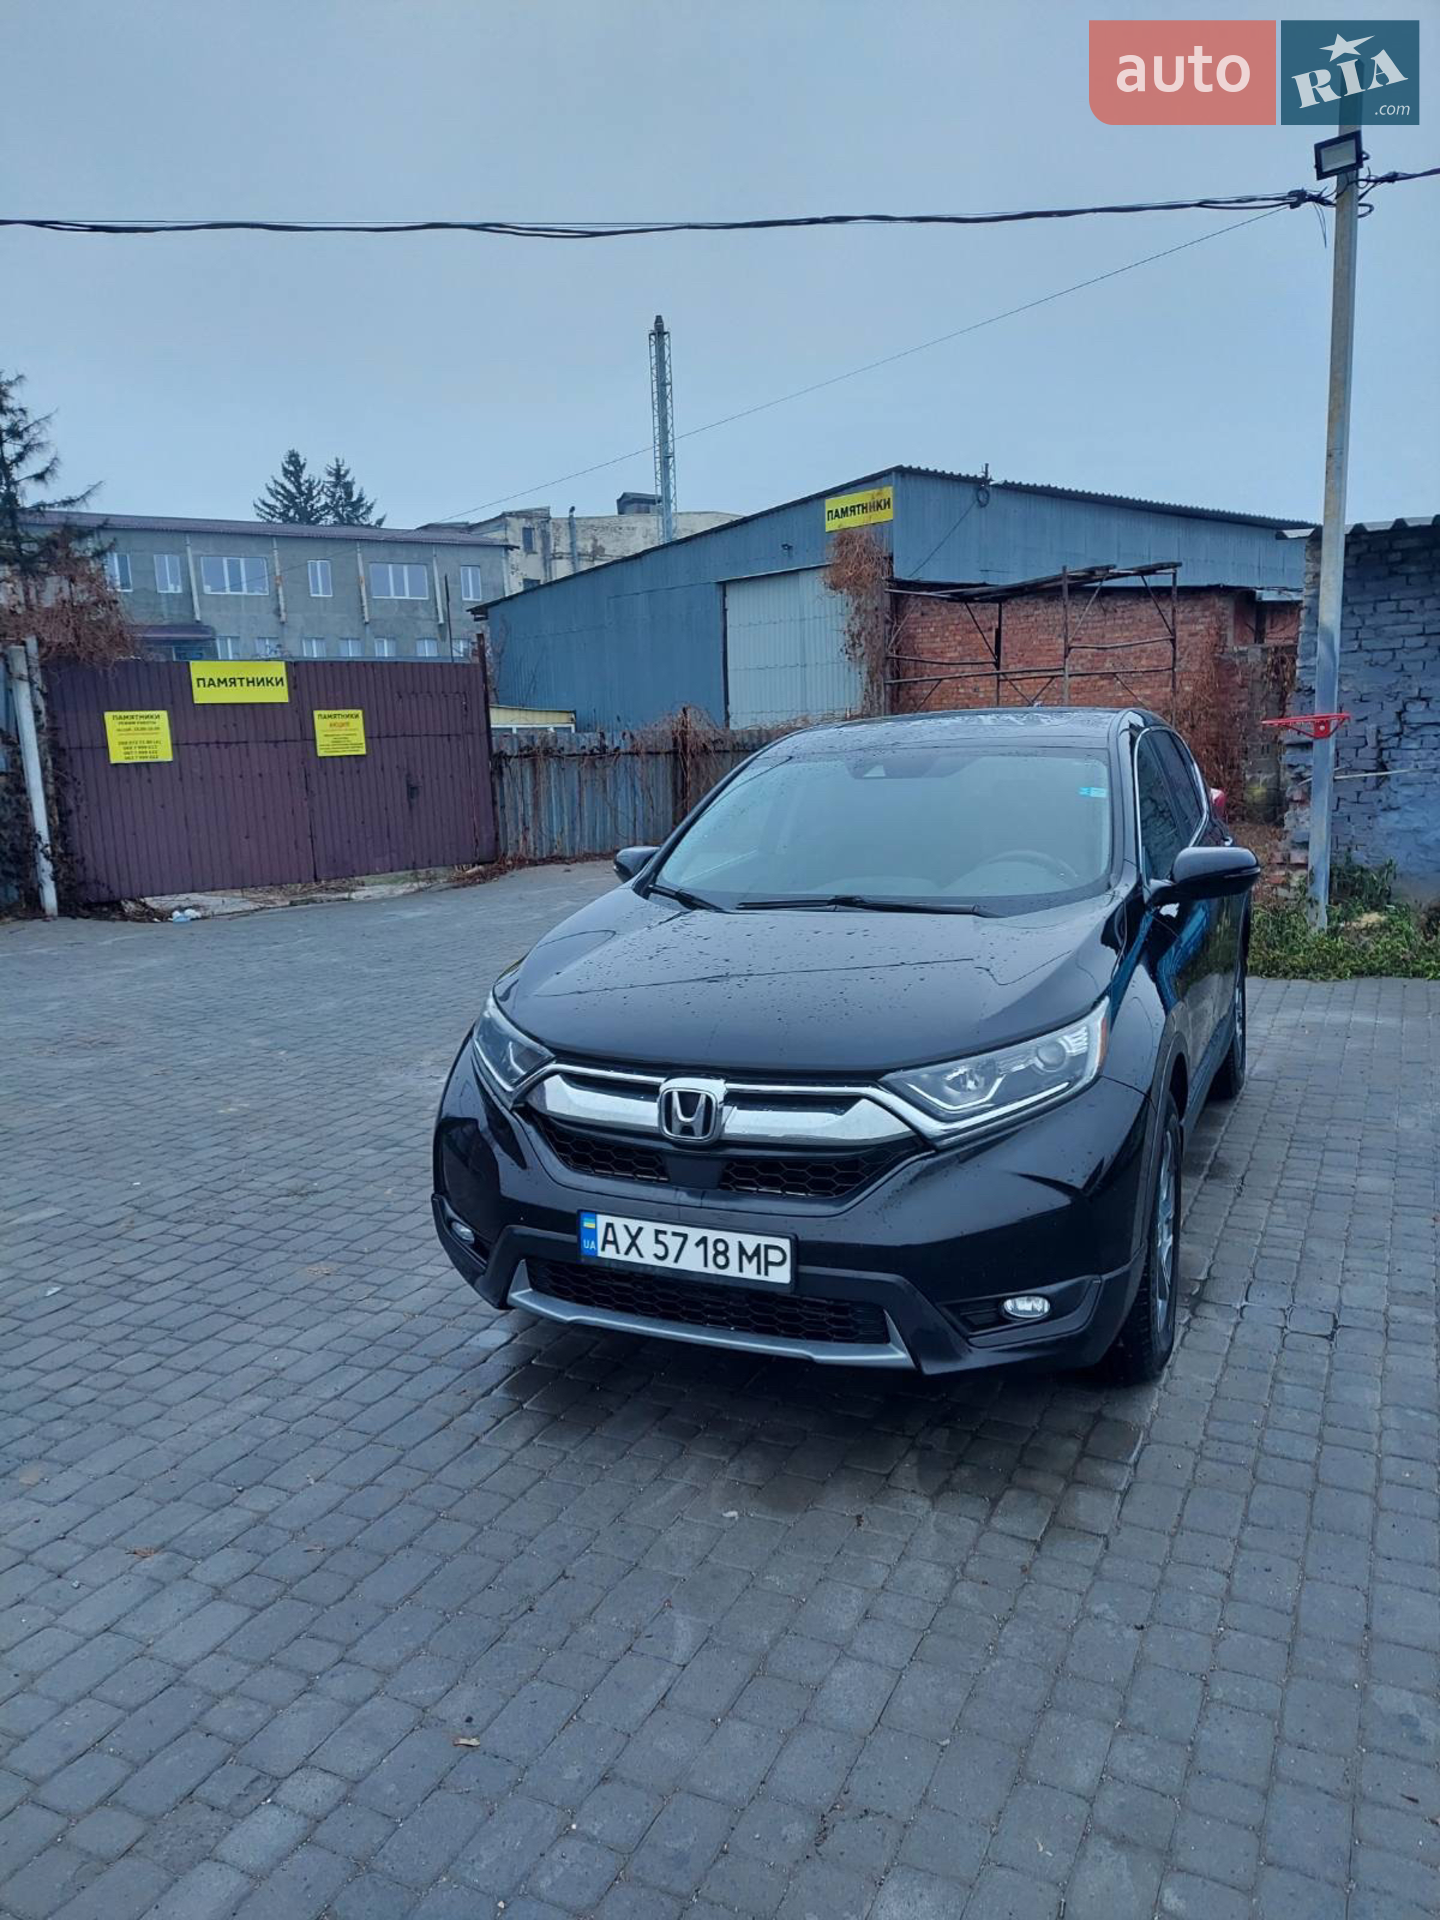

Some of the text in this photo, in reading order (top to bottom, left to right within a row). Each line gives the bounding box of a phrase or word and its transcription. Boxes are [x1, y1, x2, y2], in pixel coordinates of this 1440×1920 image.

[827, 497, 891, 521] ПАМЯТНИКИ
[196, 676, 285, 688] ПАМЯТНИКИ
[583, 1239, 596, 1251] UA
